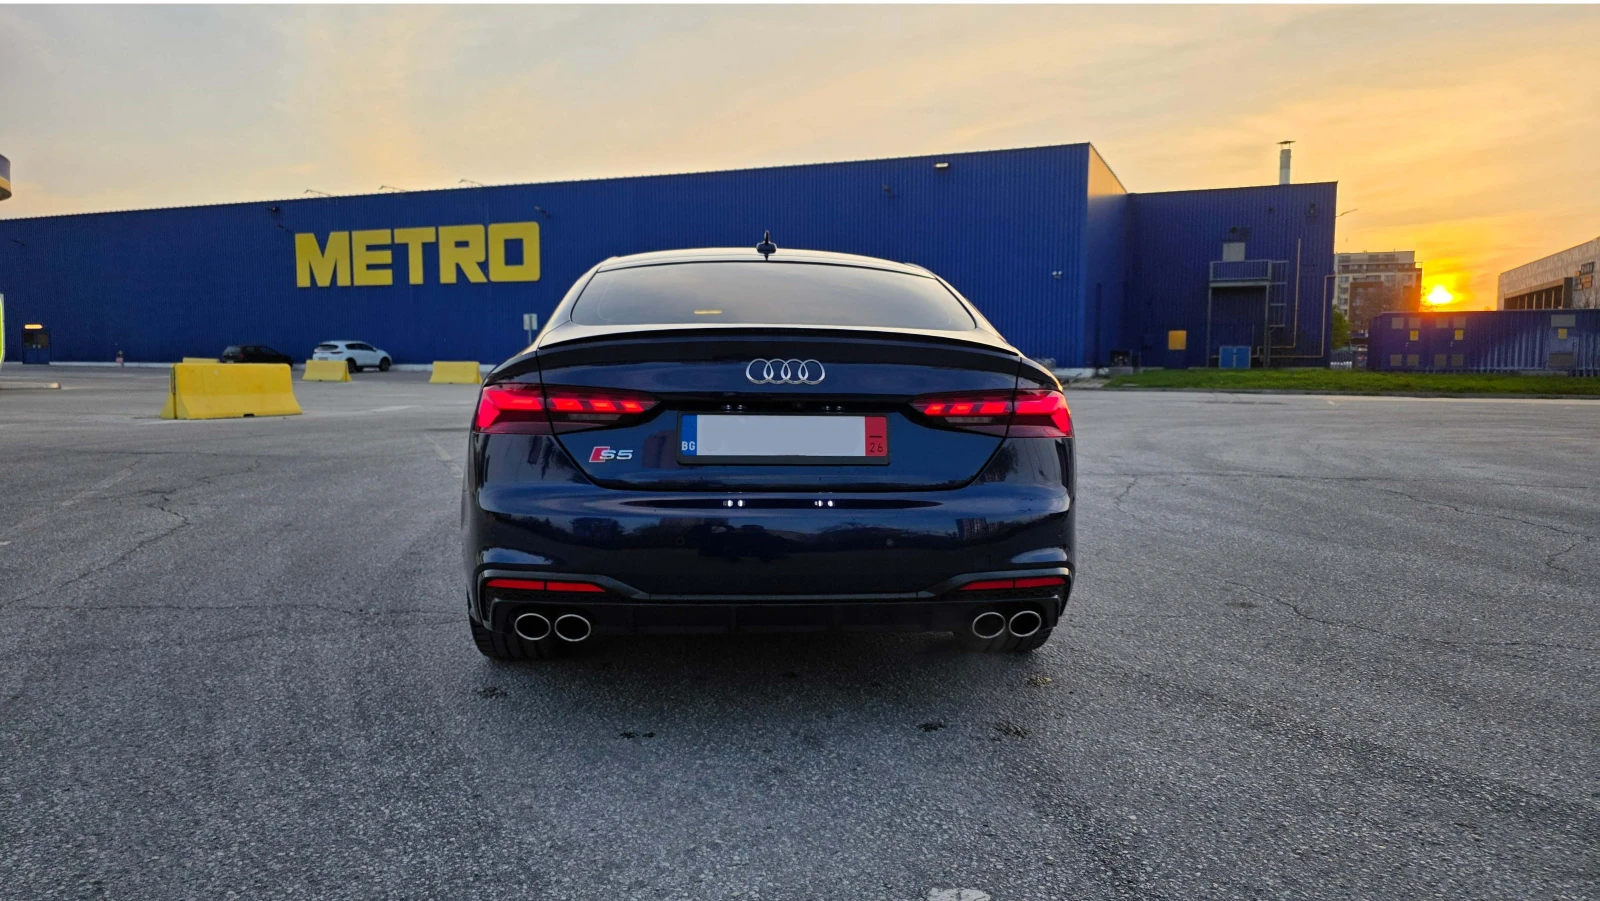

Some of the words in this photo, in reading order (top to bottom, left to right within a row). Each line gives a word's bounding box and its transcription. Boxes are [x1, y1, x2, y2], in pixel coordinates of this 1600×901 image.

[295, 221, 541, 288] METRO
[681, 440, 696, 451] BG
[869, 442, 884, 453] 26
[599, 449, 634, 460] S5
